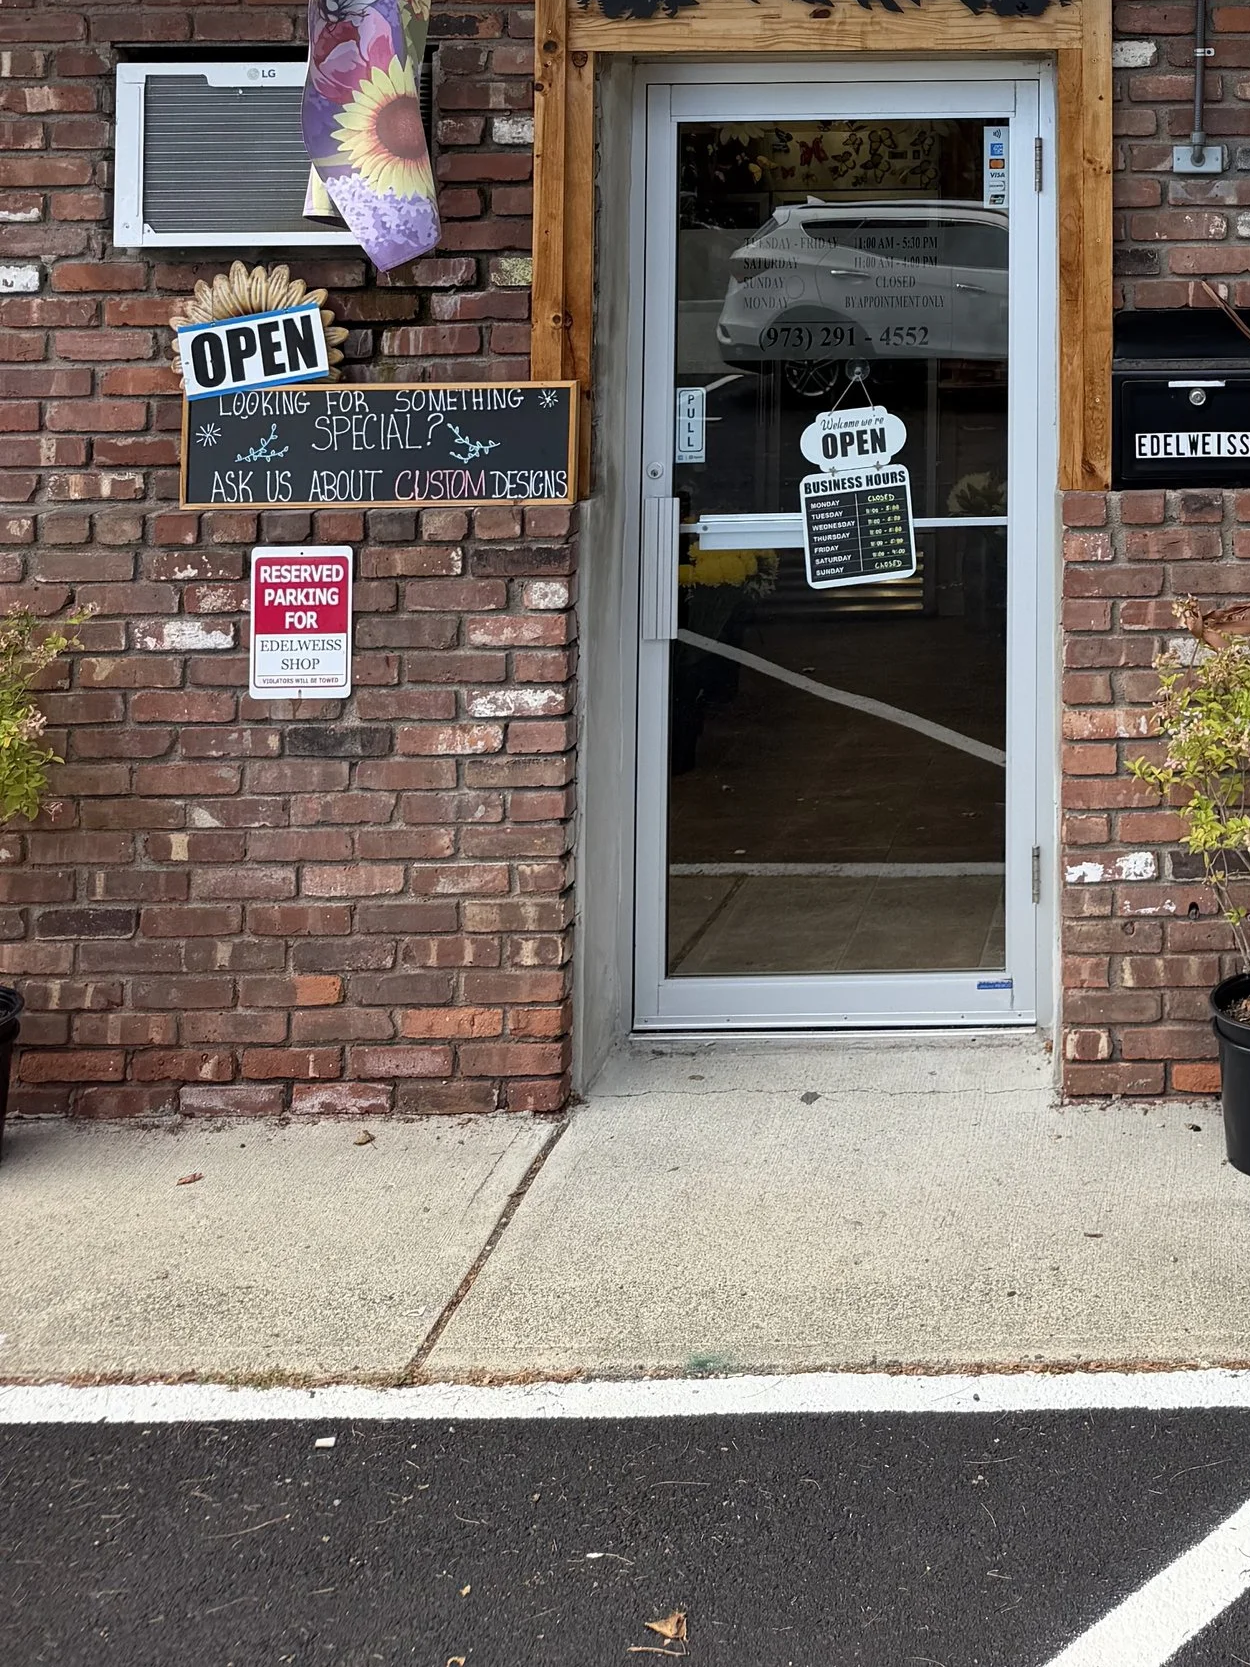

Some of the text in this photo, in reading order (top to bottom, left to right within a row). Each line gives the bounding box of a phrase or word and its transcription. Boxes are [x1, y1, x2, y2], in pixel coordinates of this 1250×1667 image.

[261, 69, 276, 78] LG
[743, 236, 793, 250] TUESDAY
[800, 236, 839, 250] FRIDAY
[854, 236, 876, 249] 11:00
[878, 236, 894, 249] AM
[902, 236, 921, 249] 5:30
[922, 236, 938, 249] PM
[743, 256, 799, 270] SATURDAY
[878, 256, 894, 268] AM
[922, 255, 938, 267] PM
[743, 275, 916, 289] SUNDAY CLOSED
[743, 296, 788, 309] MONDAY
[857, 295, 921, 308] APPOINTMENT
[922, 295, 945, 308] ONLY
[759, 326, 813, 352] (973)
[820, 326, 856, 347] 291
[879, 325, 929, 346] 4552
[190, 314, 319, 389] OPEN
[219, 388, 525, 417] LOOKING FOR SOMETHING
[687, 394, 695, 447] PULL
[821, 417, 860, 431] Welcome
[821, 427, 887, 460] OPEN
[1137, 433, 1250, 457] EDELWEISS
[210, 469, 569, 503] ASK US ABOUT CUSTOM DESIGNS
[803, 470, 907, 495] BUSINESS HOURS
[810, 500, 840, 510] MONDAY
[811, 510, 844, 521] TUESDAY
[812, 520, 856, 532] WEDNESDAY
[813, 532, 851, 543] THURSDAY
[814, 545, 839, 554] FRIDAY
[815, 554, 852, 565] SATURDAY
[260, 564, 345, 583] RESERVED
[815, 566, 845, 576] SUNDAY
[264, 587, 340, 607] PARKING
[284, 611, 319, 630] FOR
[260, 638, 342, 652] EDELWEISS
[281, 658, 320, 671] SHOP
